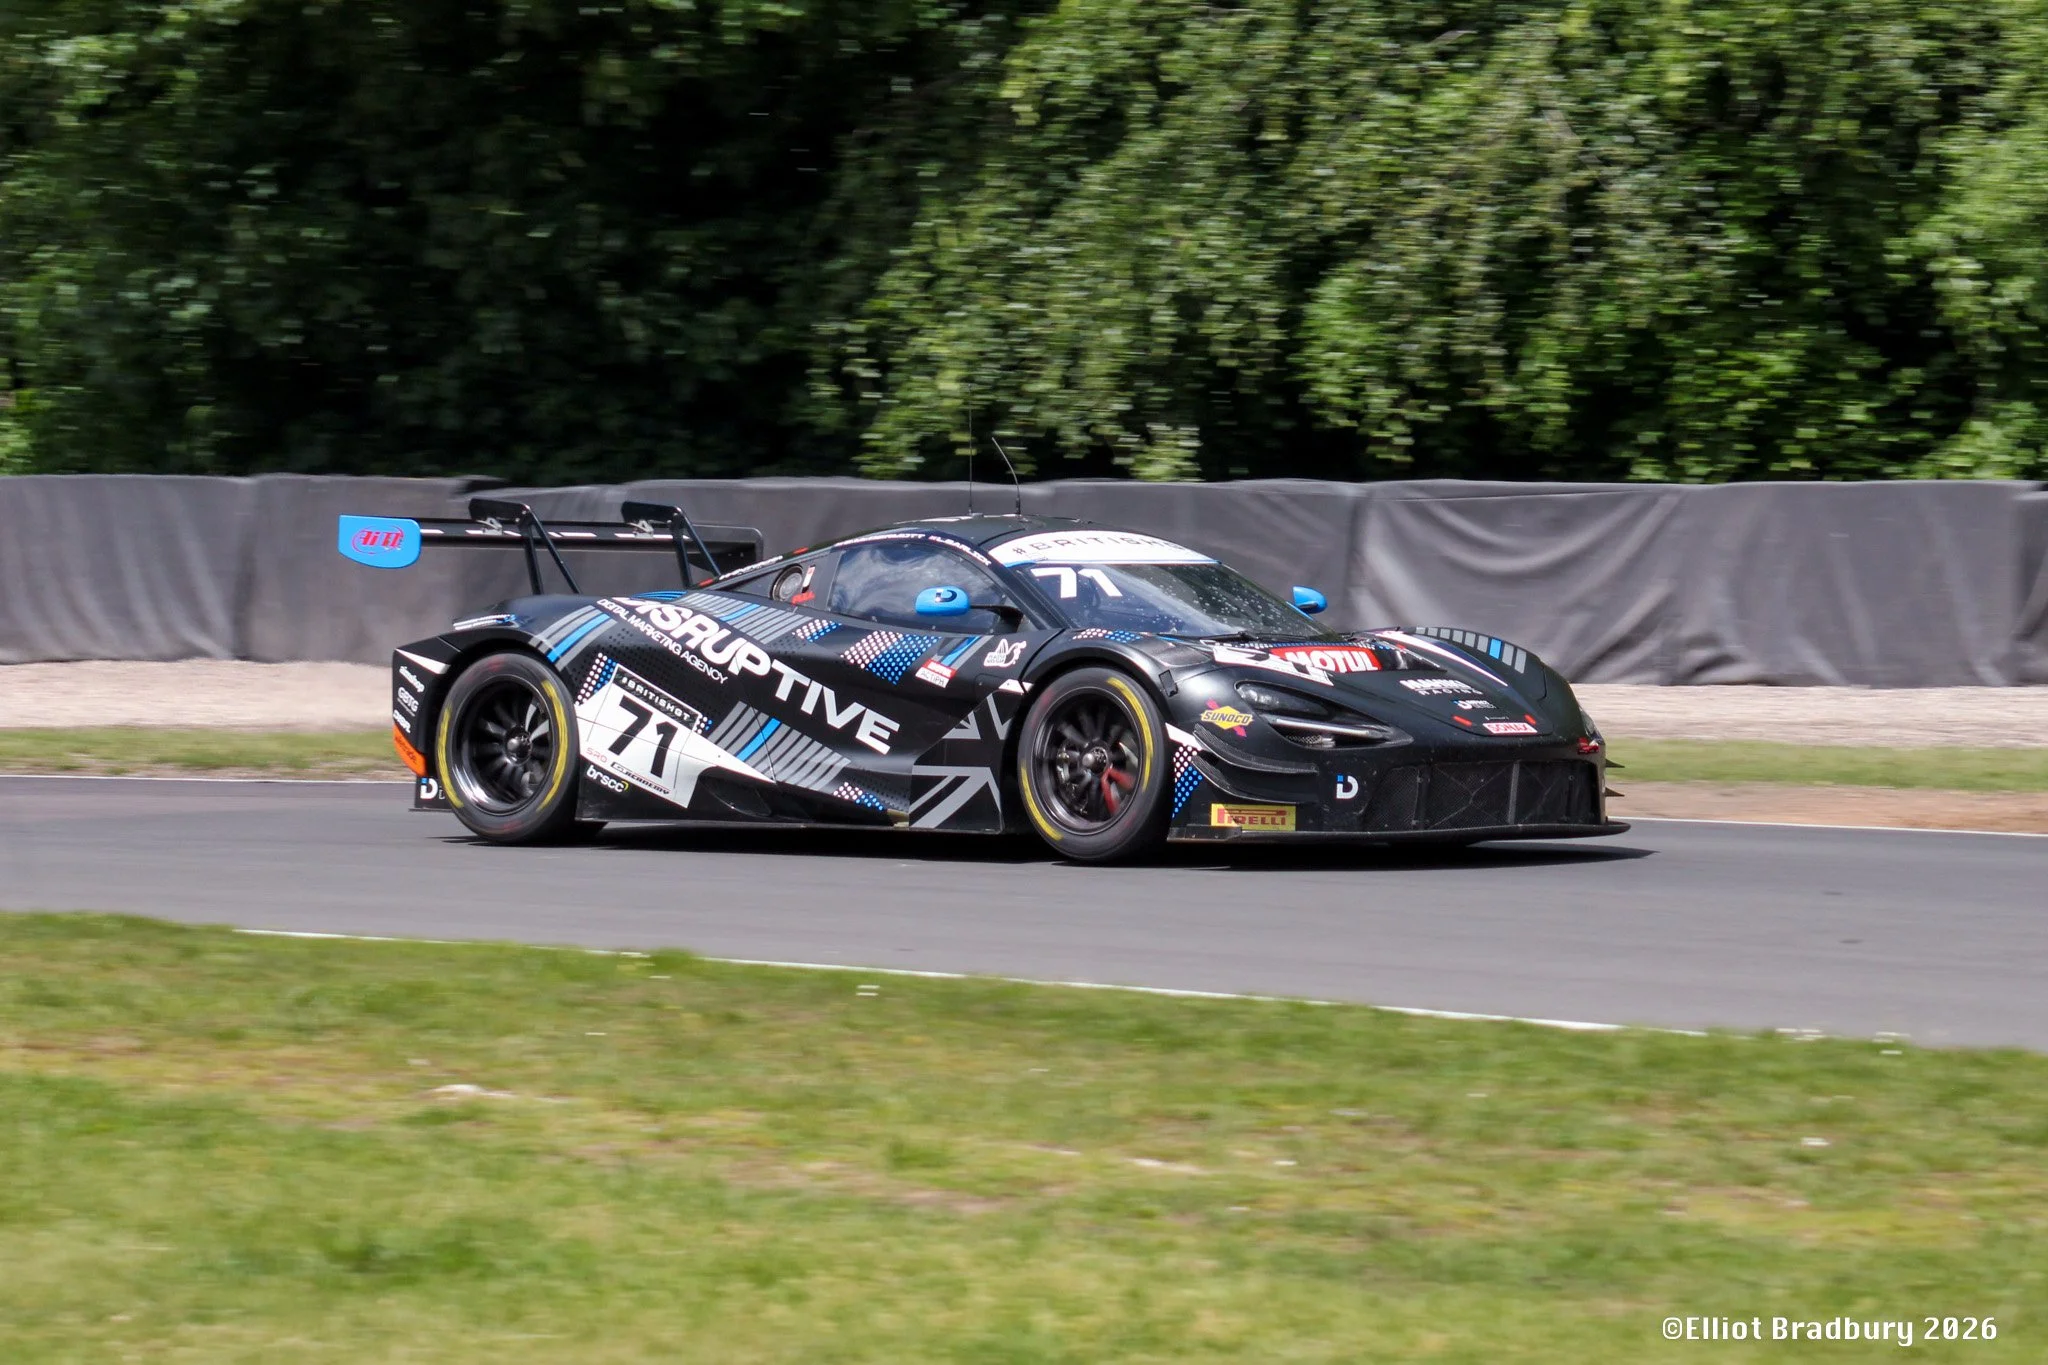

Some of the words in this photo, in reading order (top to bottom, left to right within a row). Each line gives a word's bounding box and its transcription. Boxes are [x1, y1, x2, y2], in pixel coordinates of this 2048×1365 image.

[1030, 567, 1123, 599] 71
[596, 598, 630, 621] DIGITAL
[626, 614, 682, 656] MARKETING
[680, 650, 728, 684] AGENCY
[1285, 651, 1379, 673] MOTUL
[1203, 711, 1251, 725] SUNOCO
[608, 694, 679, 780] 71
[586, 764, 626, 793] brscc
[1216, 807, 1288, 826] PIRELLI
